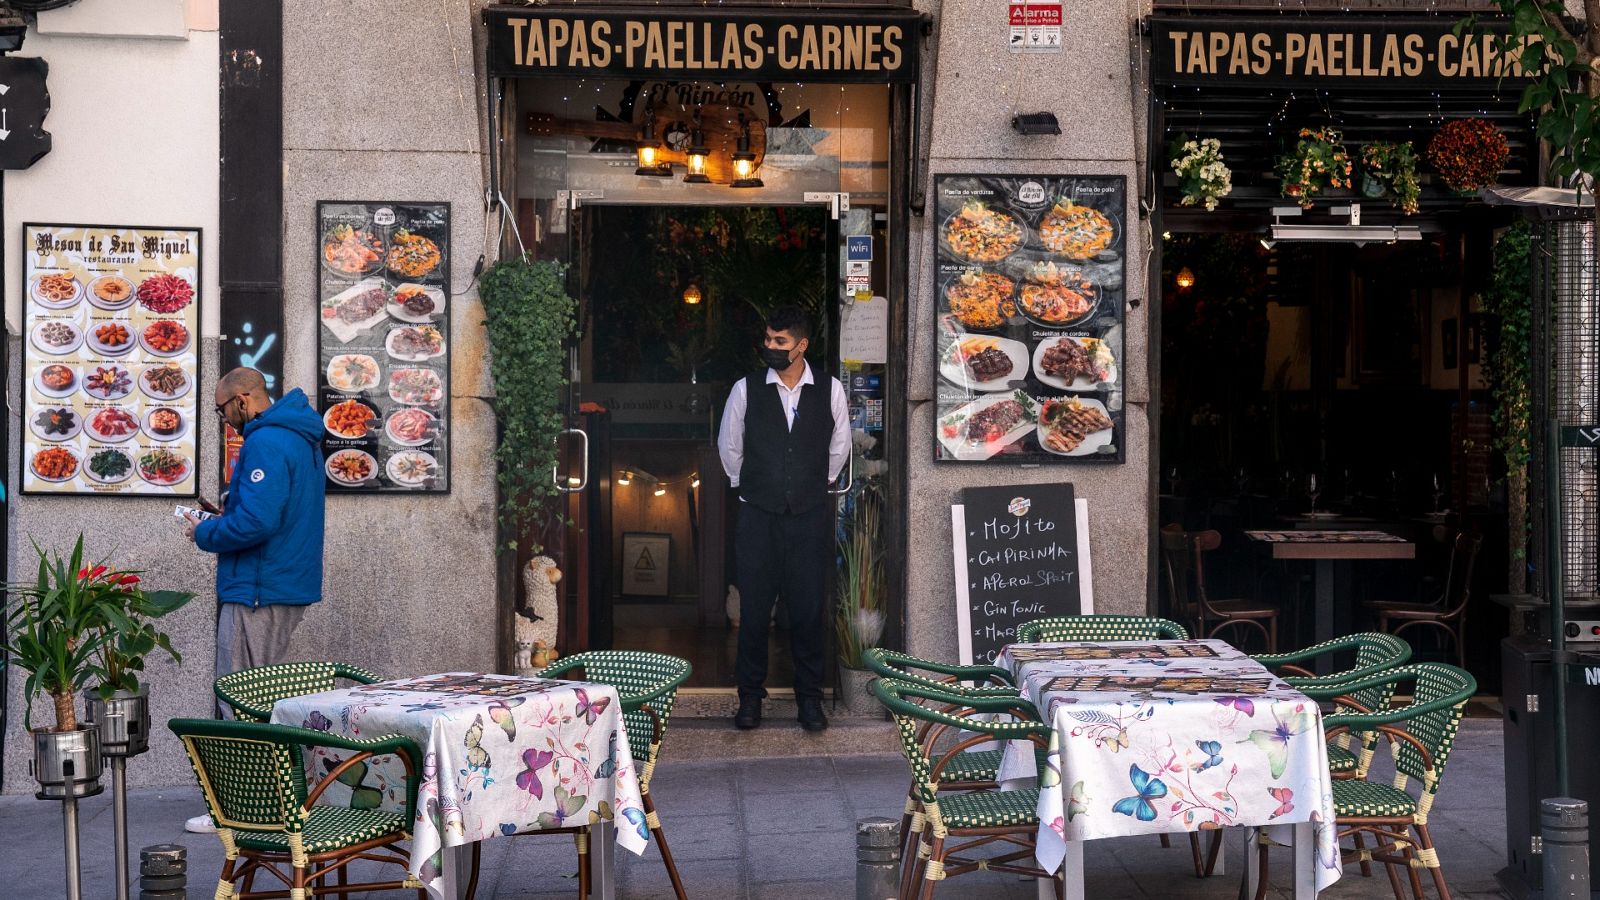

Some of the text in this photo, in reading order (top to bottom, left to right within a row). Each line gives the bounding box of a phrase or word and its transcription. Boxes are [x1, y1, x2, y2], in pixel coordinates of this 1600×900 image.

[1013, 7, 1059, 18] Alarma
[676, 82, 755, 106] Rincón
[88, 235, 103, 252] de
[108, 234, 135, 255] San
[142, 235, 190, 260] Miguel
[83, 255, 135, 264] restaurante
